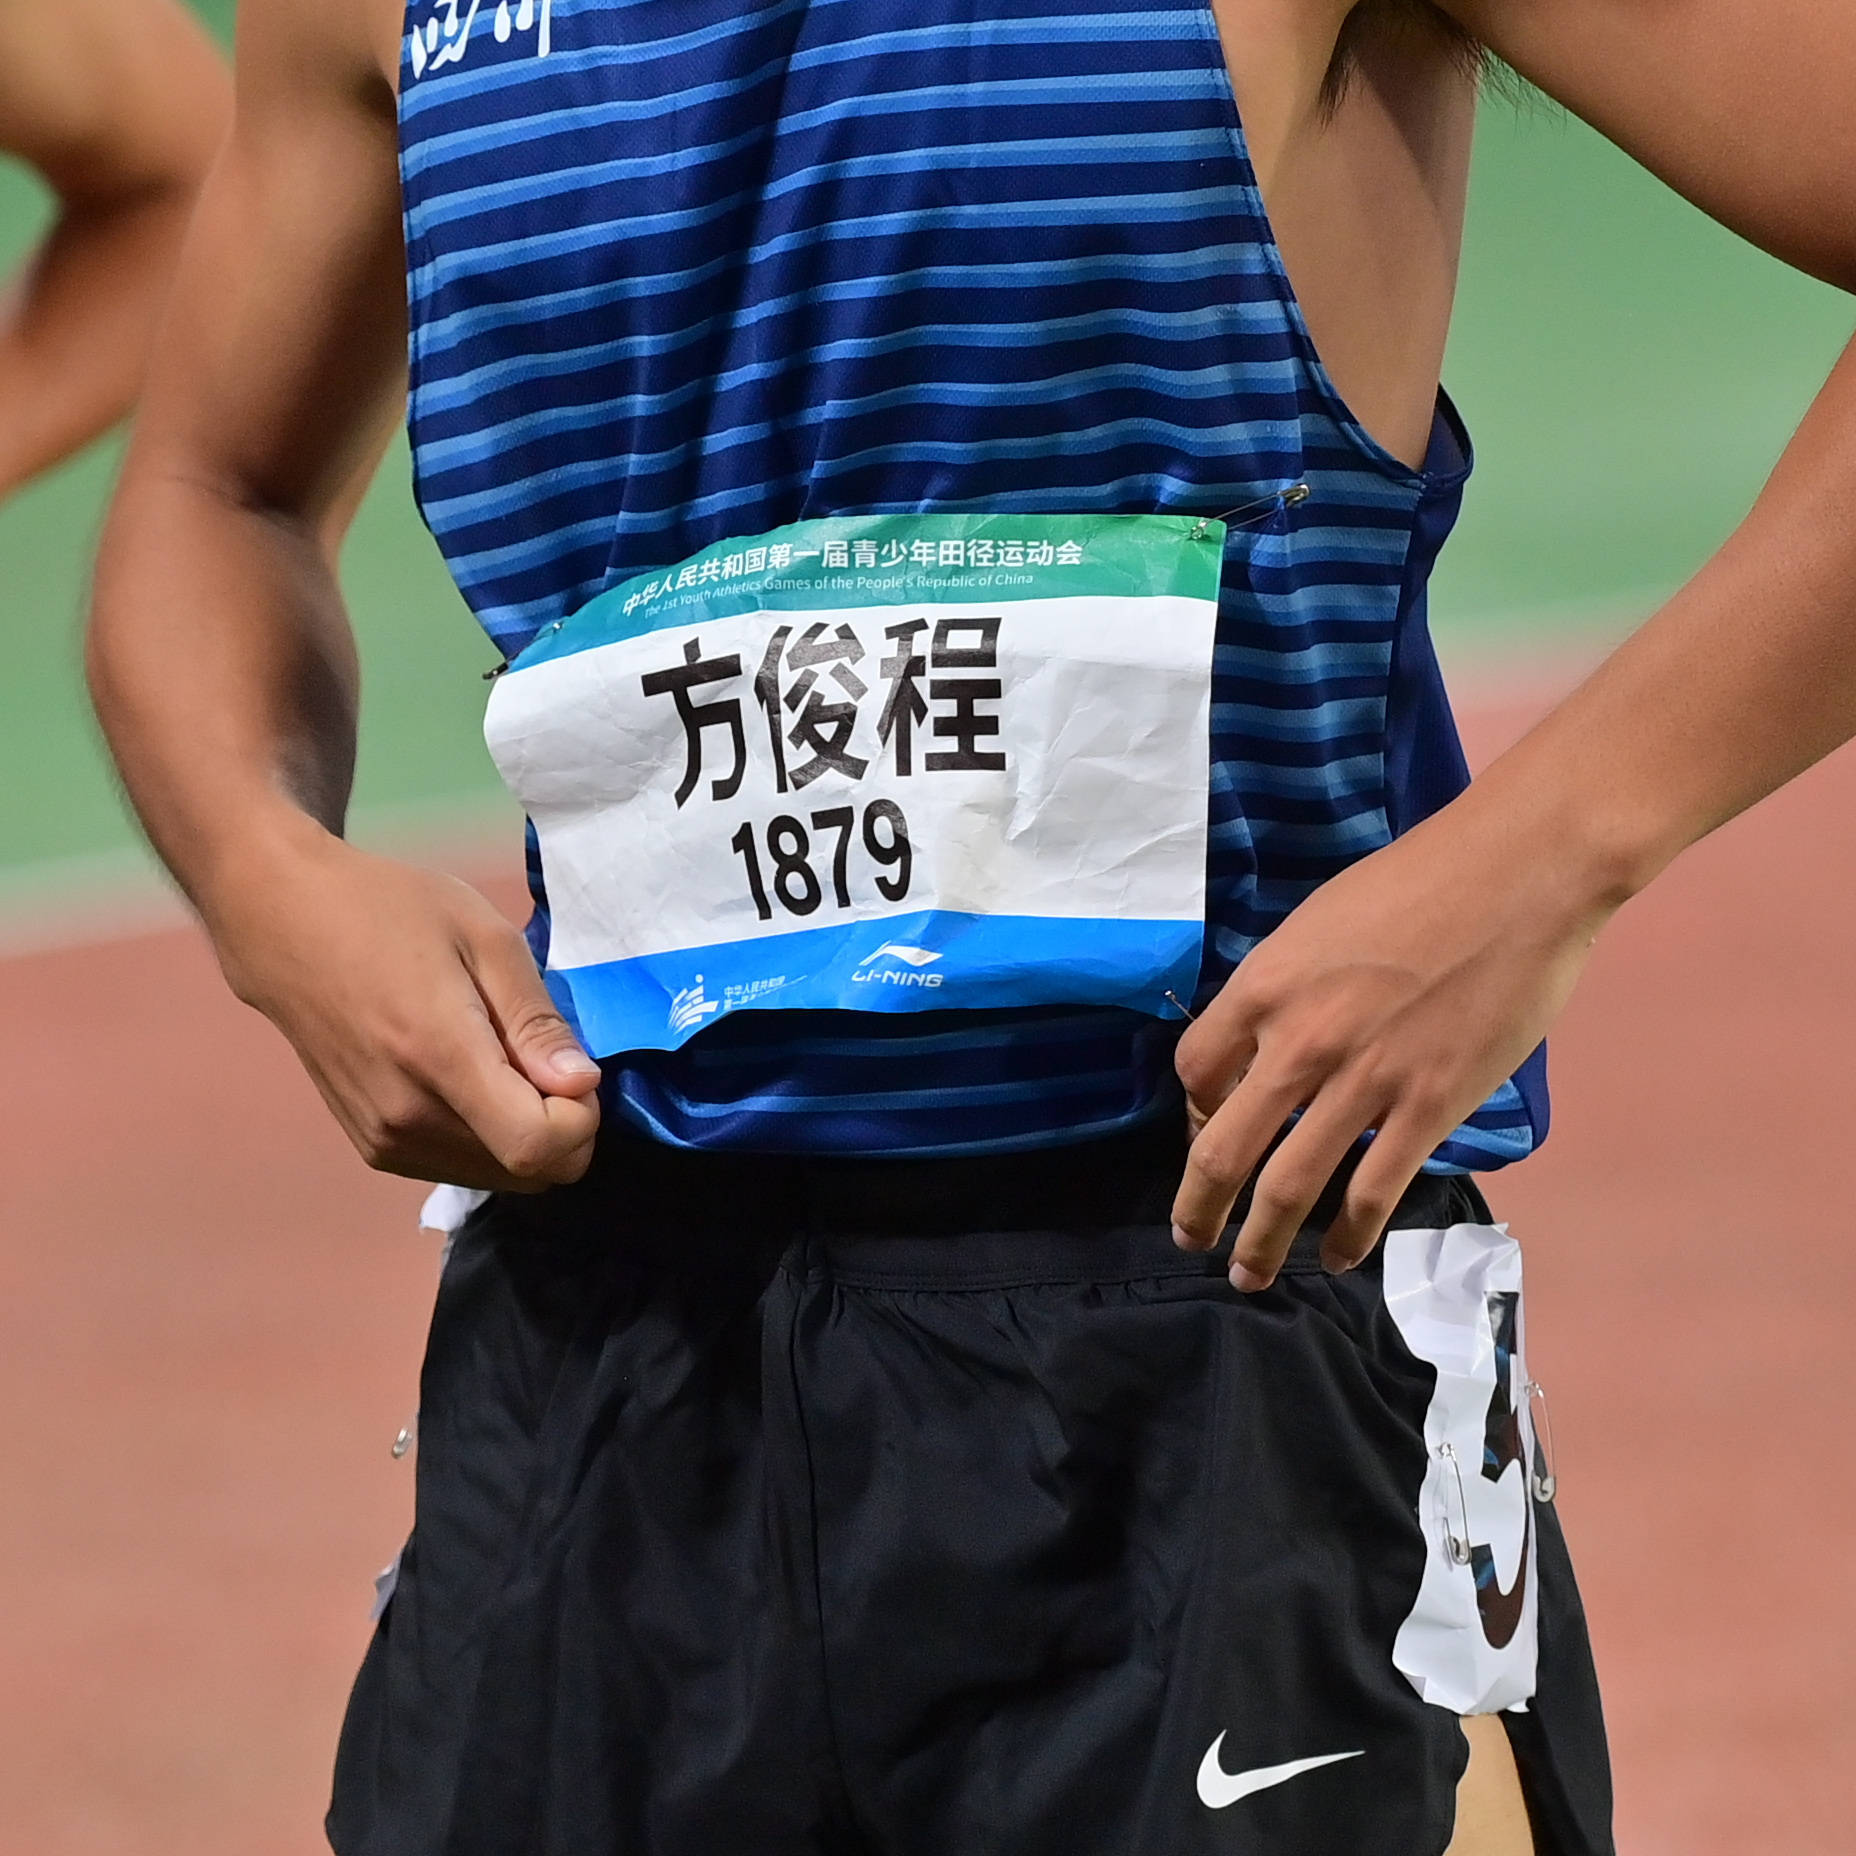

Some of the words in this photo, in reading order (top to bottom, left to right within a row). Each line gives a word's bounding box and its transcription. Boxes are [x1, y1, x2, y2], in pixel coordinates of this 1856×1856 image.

[622, 539, 1083, 617] 中华人民共和国第一届青少年田径运动会
[662, 596, 678, 611] 1st
[679, 589, 712, 607] Youth
[711, 580, 762, 599] Athletics
[764, 575, 810, 591] Games
[814, 575, 830, 590] of
[831, 574, 854, 590] the
[856, 575, 914, 591] People's
[916, 574, 976, 590] Republic
[978, 573, 993, 588] of
[994, 573, 1034, 586] China
[641, 615, 1007, 811] 方俊程
[731, 797, 913, 922] 1879
[851, 969, 944, 988] LI-NING
